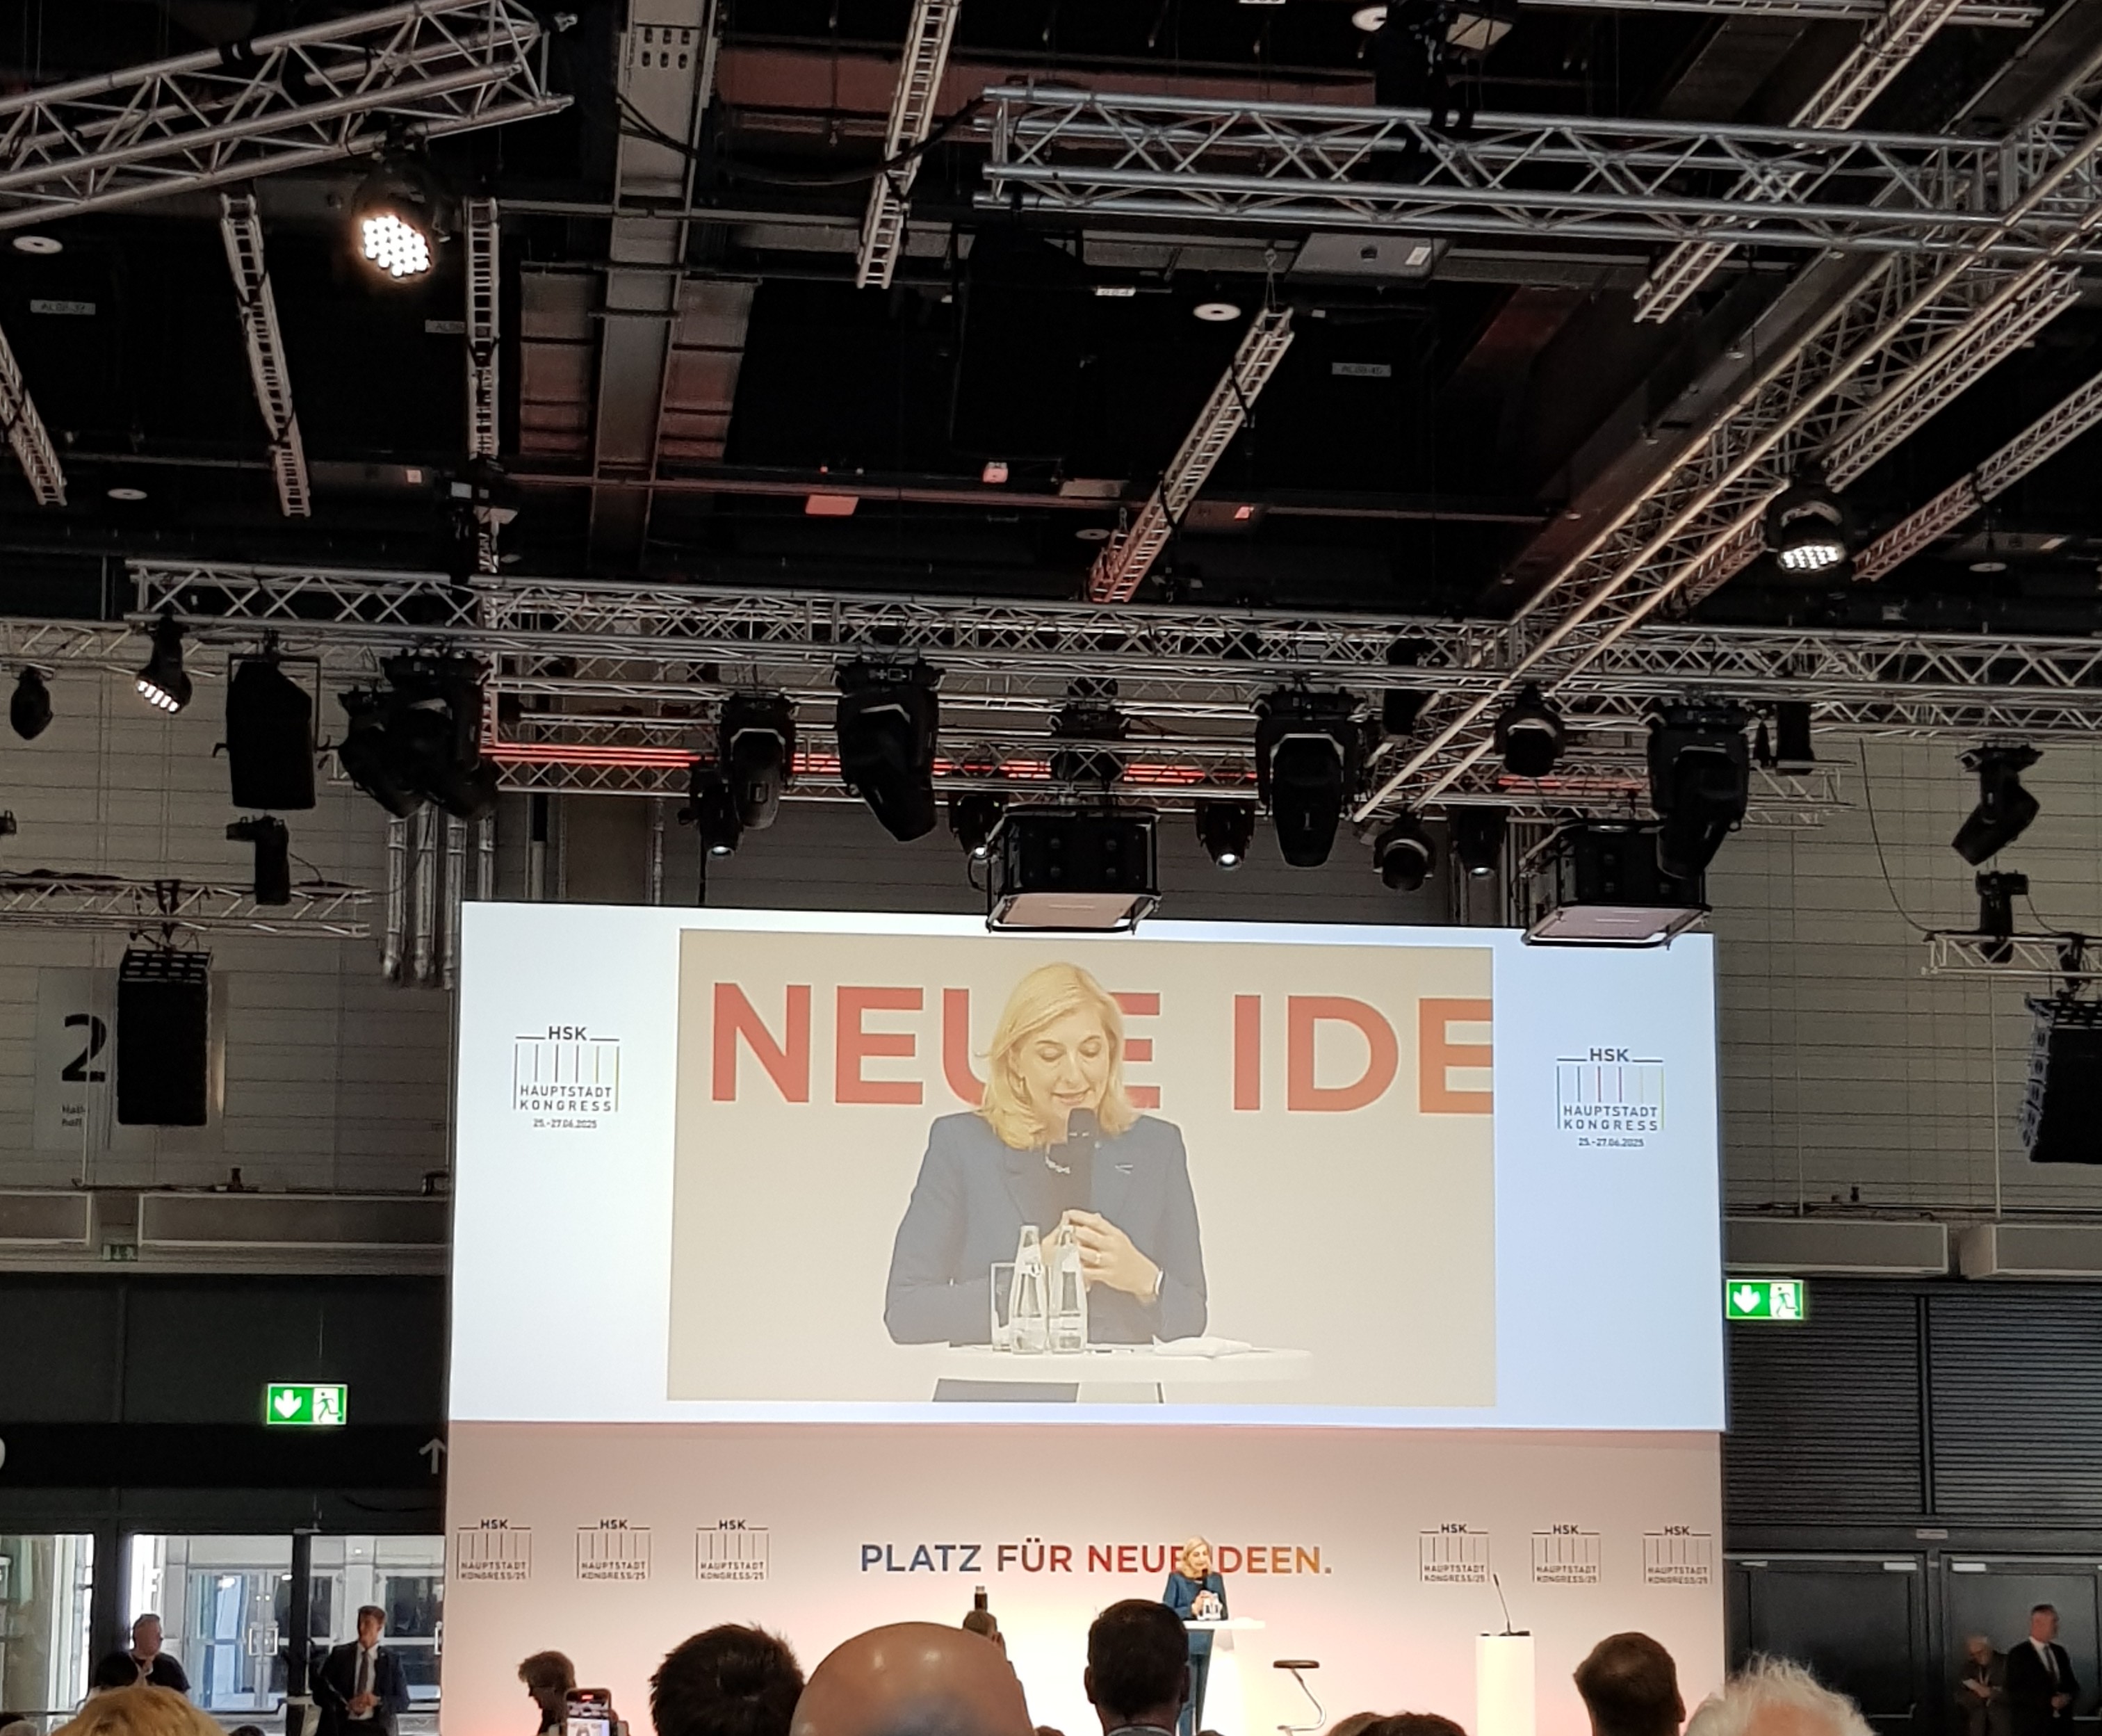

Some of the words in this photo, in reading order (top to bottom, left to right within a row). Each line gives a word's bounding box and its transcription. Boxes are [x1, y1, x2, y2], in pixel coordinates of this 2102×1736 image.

[548, 1025, 587, 1041] HSK
[62, 1014, 106, 1082] 2
[1233, 994, 1493, 1114] IDE
[1590, 1048, 1630, 1063] HSK
[520, 1084, 612, 1098] HAUPTSTADT
[519, 1099, 612, 1112] KONGRESS
[1563, 1105, 1658, 1117] HAUPTSTADT
[1563, 1119, 1658, 1131] KONGRESS
[480, 1518, 508, 1530] HSK
[599, 1519, 628, 1530] HSK
[718, 1519, 747, 1531] HSK
[1441, 1523, 1467, 1534] HSK
[1553, 1524, 1579, 1535] HSK
[1664, 1525, 1690, 1536] HSK
[861, 1543, 981, 1572] PLATZ
[997, 1537, 1073, 1573] FÜR
[461, 1561, 526, 1570] HAUPTSTADT
[581, 1561, 645, 1570] HAUPTSTADT
[700, 1561, 764, 1570] HAUPTSTADT
[1424, 1564, 1485, 1573] HAUPTSTADT
[1536, 1565, 1596, 1574] HAUPTSTADT
[1647, 1566, 1707, 1575] HAUPTSTADT
